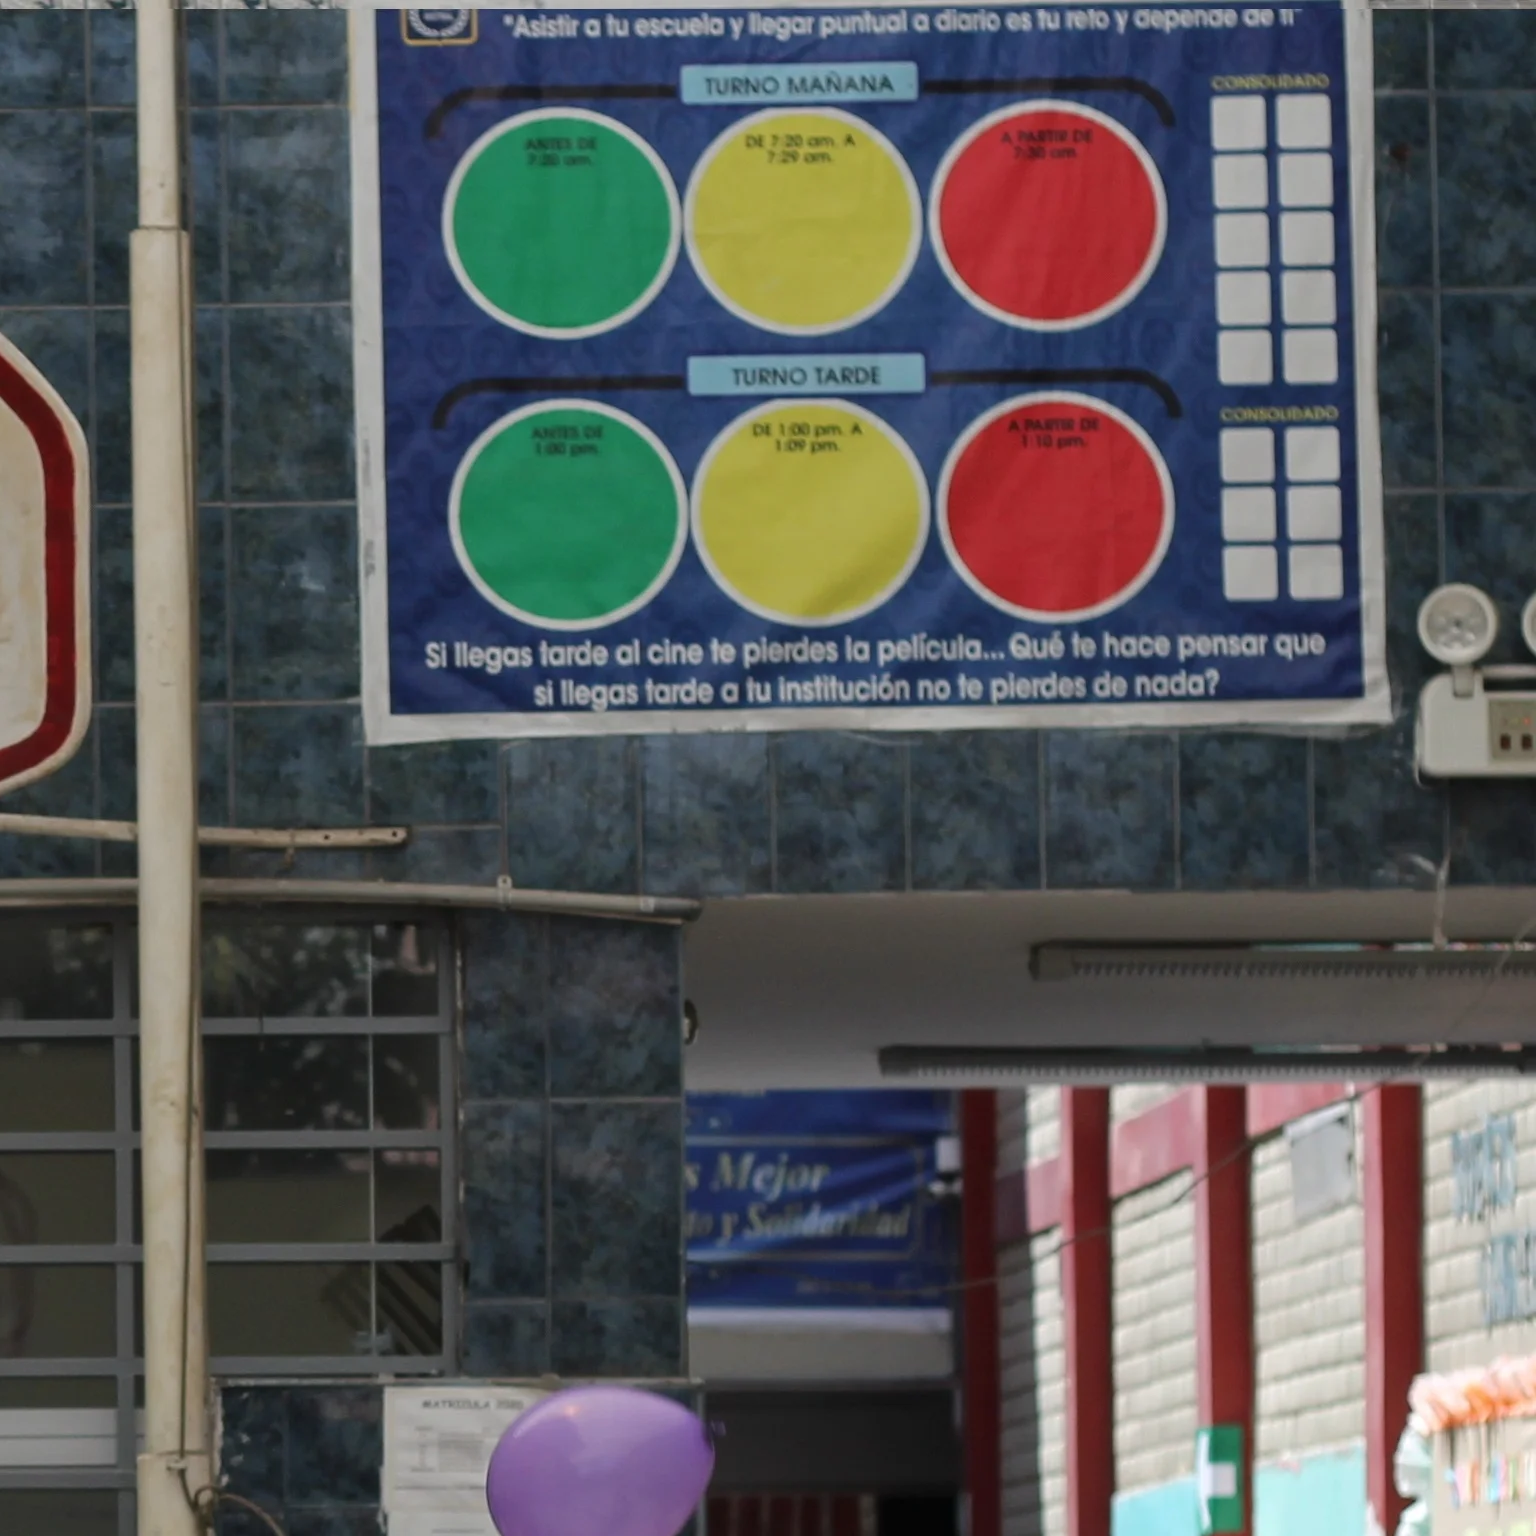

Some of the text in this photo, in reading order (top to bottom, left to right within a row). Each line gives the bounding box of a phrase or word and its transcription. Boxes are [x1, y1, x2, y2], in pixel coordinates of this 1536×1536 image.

[503, 14, 578, 38] "Asistir
[584, 20, 600, 37] a
[606, 14, 629, 36] tu
[635, 12, 725, 37] escuela
[729, 17, 744, 41] y
[749, 11, 815, 41] llegar
[819, 10, 907, 40] puntual
[913, 15, 929, 32] a
[935, 8, 1000, 33] diario
[1005, 14, 1032, 31] es
[1037, 9, 1060, 31] tu
[1065, 9, 1109, 30] reto
[1114, 12, 1129, 34] y
[1133, 9, 1238, 34] depende
[705, 70, 895, 96] TURNO MAÑANA
[1210, 74, 1330, 90] CONSOLIDADO
[577, 136, 597, 150] DE
[745, 135, 764, 148] DE
[770, 134, 804, 147] 7:20
[844, 134, 856, 146] A
[1001, 129, 1093, 144] A PARTIR DE
[731, 366, 881, 386] TURNO TARDE
[1220, 406, 1339, 422] CONSOLIDADO
[584, 425, 603, 439] DE
[753, 424, 771, 436] DE
[780, 423, 810, 436] 1:00
[851, 423, 862, 435] A
[1008, 418, 1099, 432] A PARTIR DE
[776, 438, 806, 451] 1:09
[426, 631, 1326, 675] Si llegas tarde al cine te pierdes la película... Qué te hace pensar que
[534, 670, 1220, 713] si llegas tarde a tu institución no te pierdes de nada?
[714, 1153, 830, 1200] Mejor
